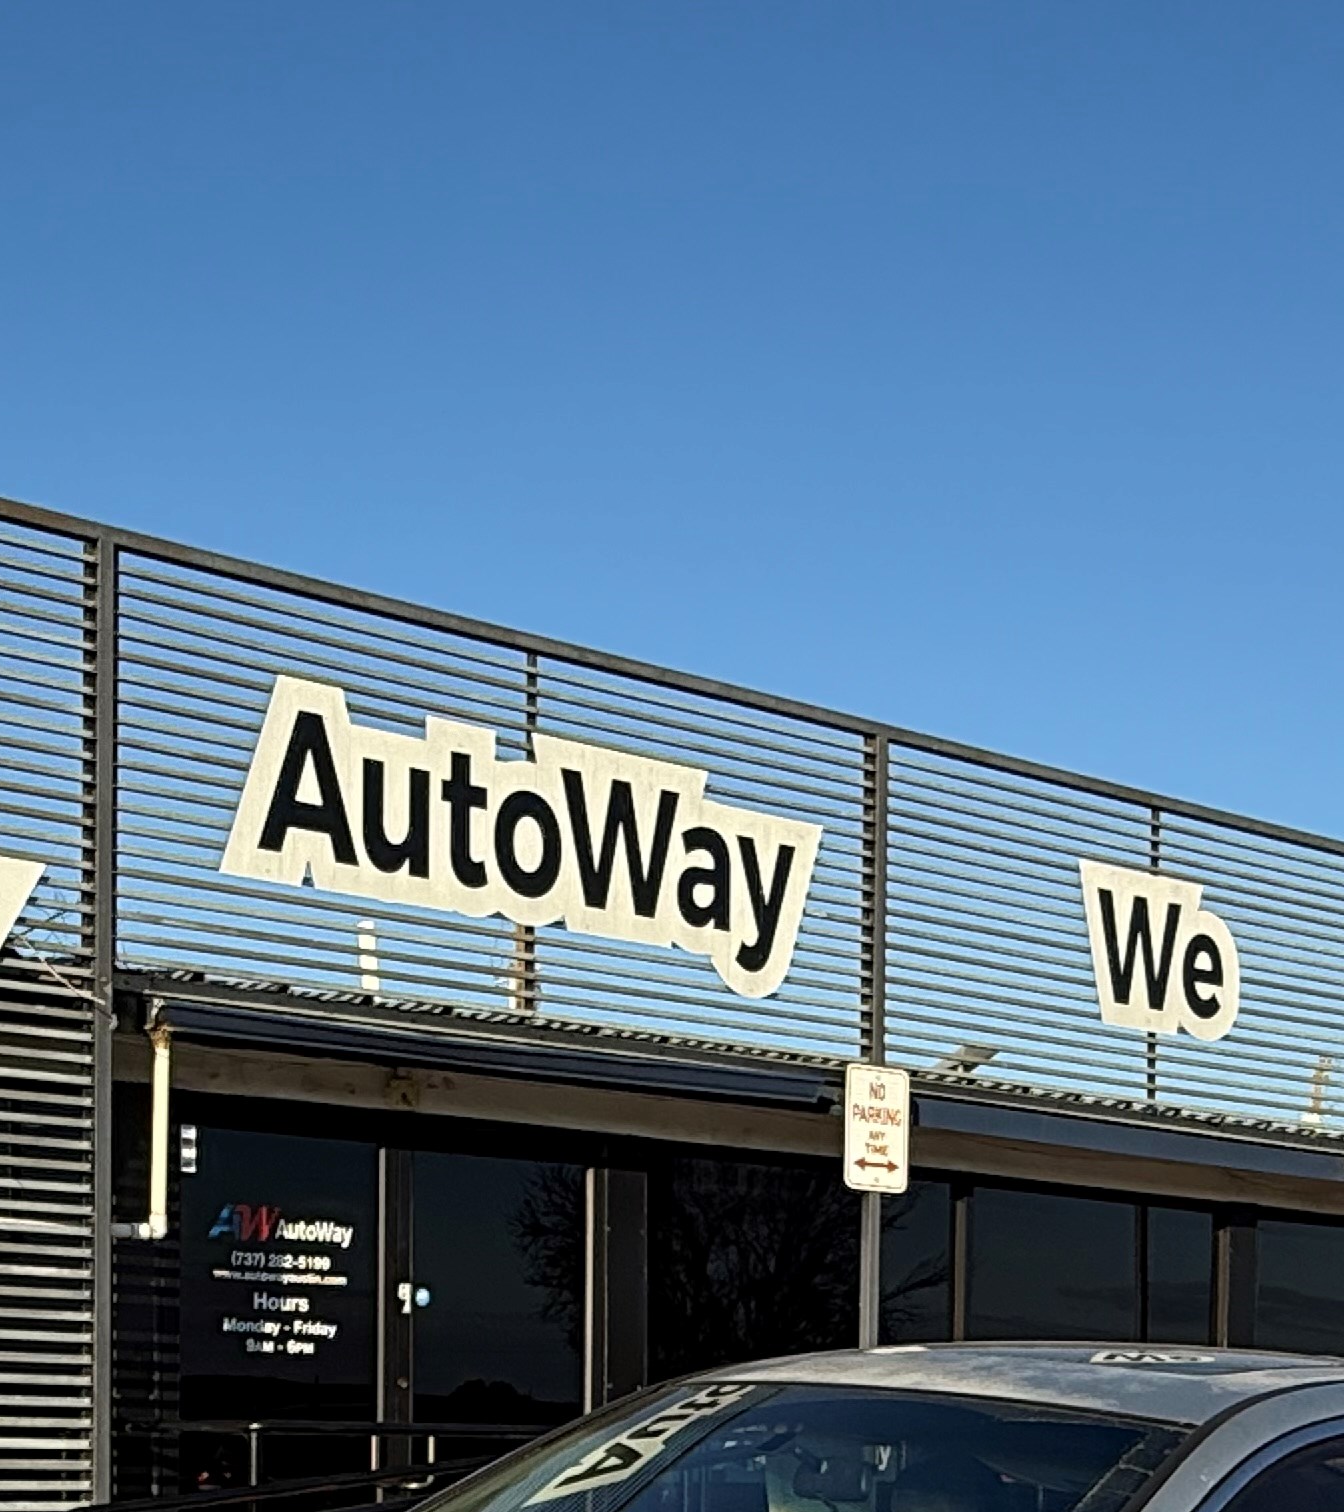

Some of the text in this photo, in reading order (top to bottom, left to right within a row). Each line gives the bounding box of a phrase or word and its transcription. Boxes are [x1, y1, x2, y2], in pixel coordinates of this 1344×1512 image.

[257, 710, 795, 973] AutoWay
[1097, 886, 1224, 1020] We
[869, 1082, 886, 1101] NO
[852, 1103, 902, 1127] PARKING
[869, 1130, 886, 1141] ANY
[864, 1142, 889, 1157] TIME
[274, 1218, 354, 1249] AutoWay
[230, 1250, 332, 1271] (737) 282-5199
[253, 1291, 310, 1312] Hours
[222, 1317, 281, 1337] Monday
[293, 1318, 338, 1340] Friday
